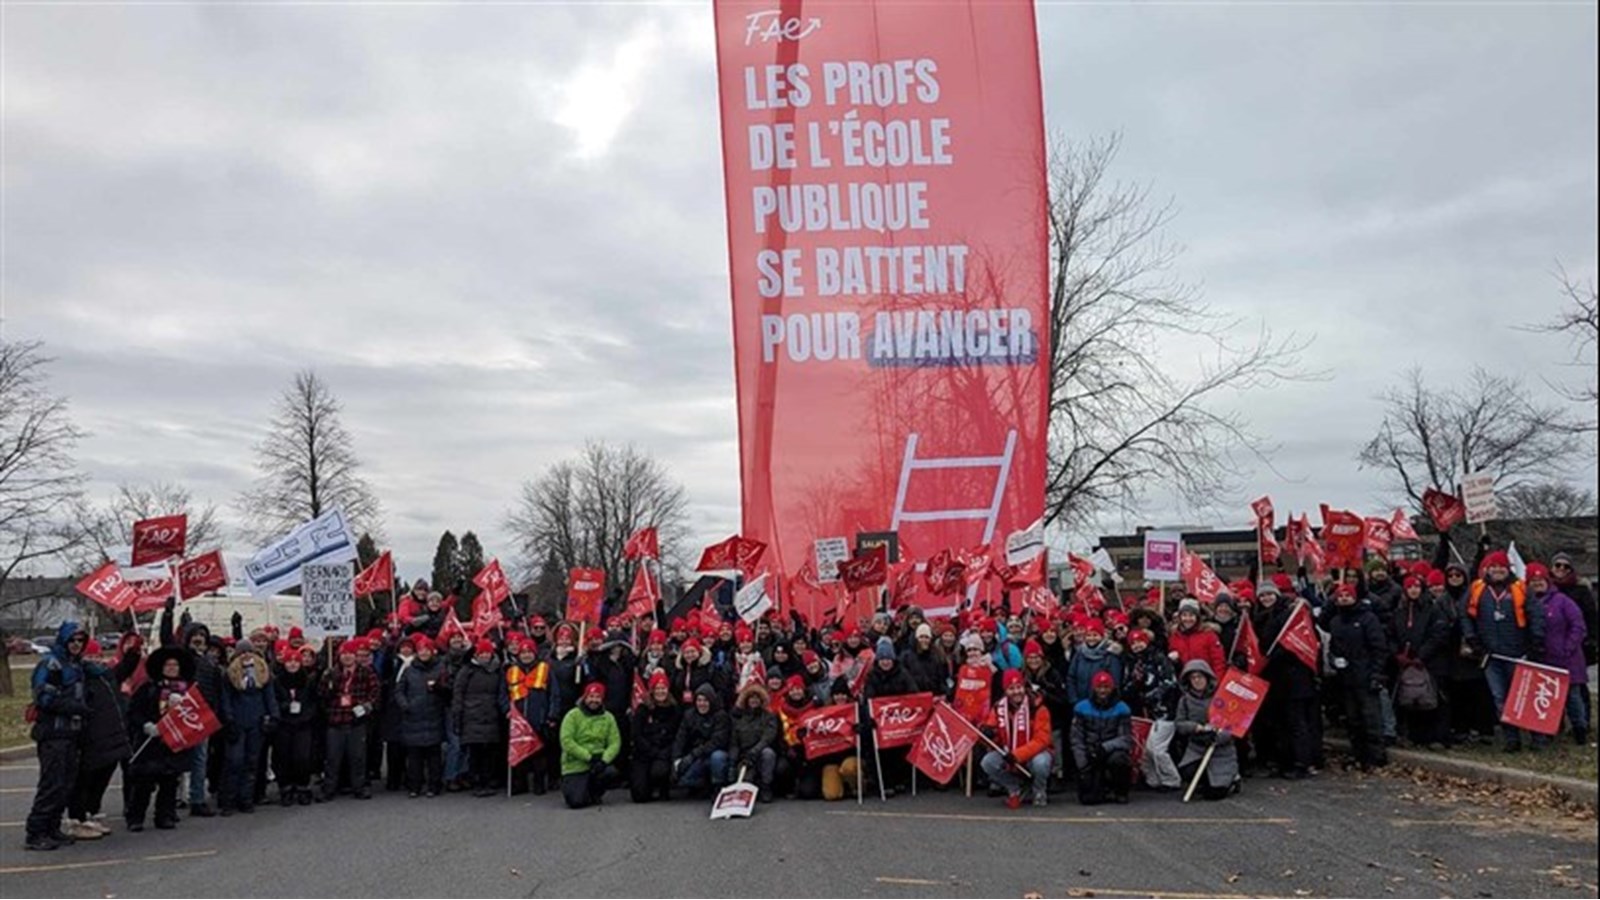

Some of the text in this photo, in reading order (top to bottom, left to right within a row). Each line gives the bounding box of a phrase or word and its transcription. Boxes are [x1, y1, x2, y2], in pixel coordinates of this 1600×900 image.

[744, 59, 940, 109] LES PROFS
[748, 110, 952, 171] DE L'ÉCOLE
[753, 181, 930, 234] PUBLIQUE
[756, 245, 968, 297] SE BATTENT
[761, 308, 1033, 363] POUR AVANCER
